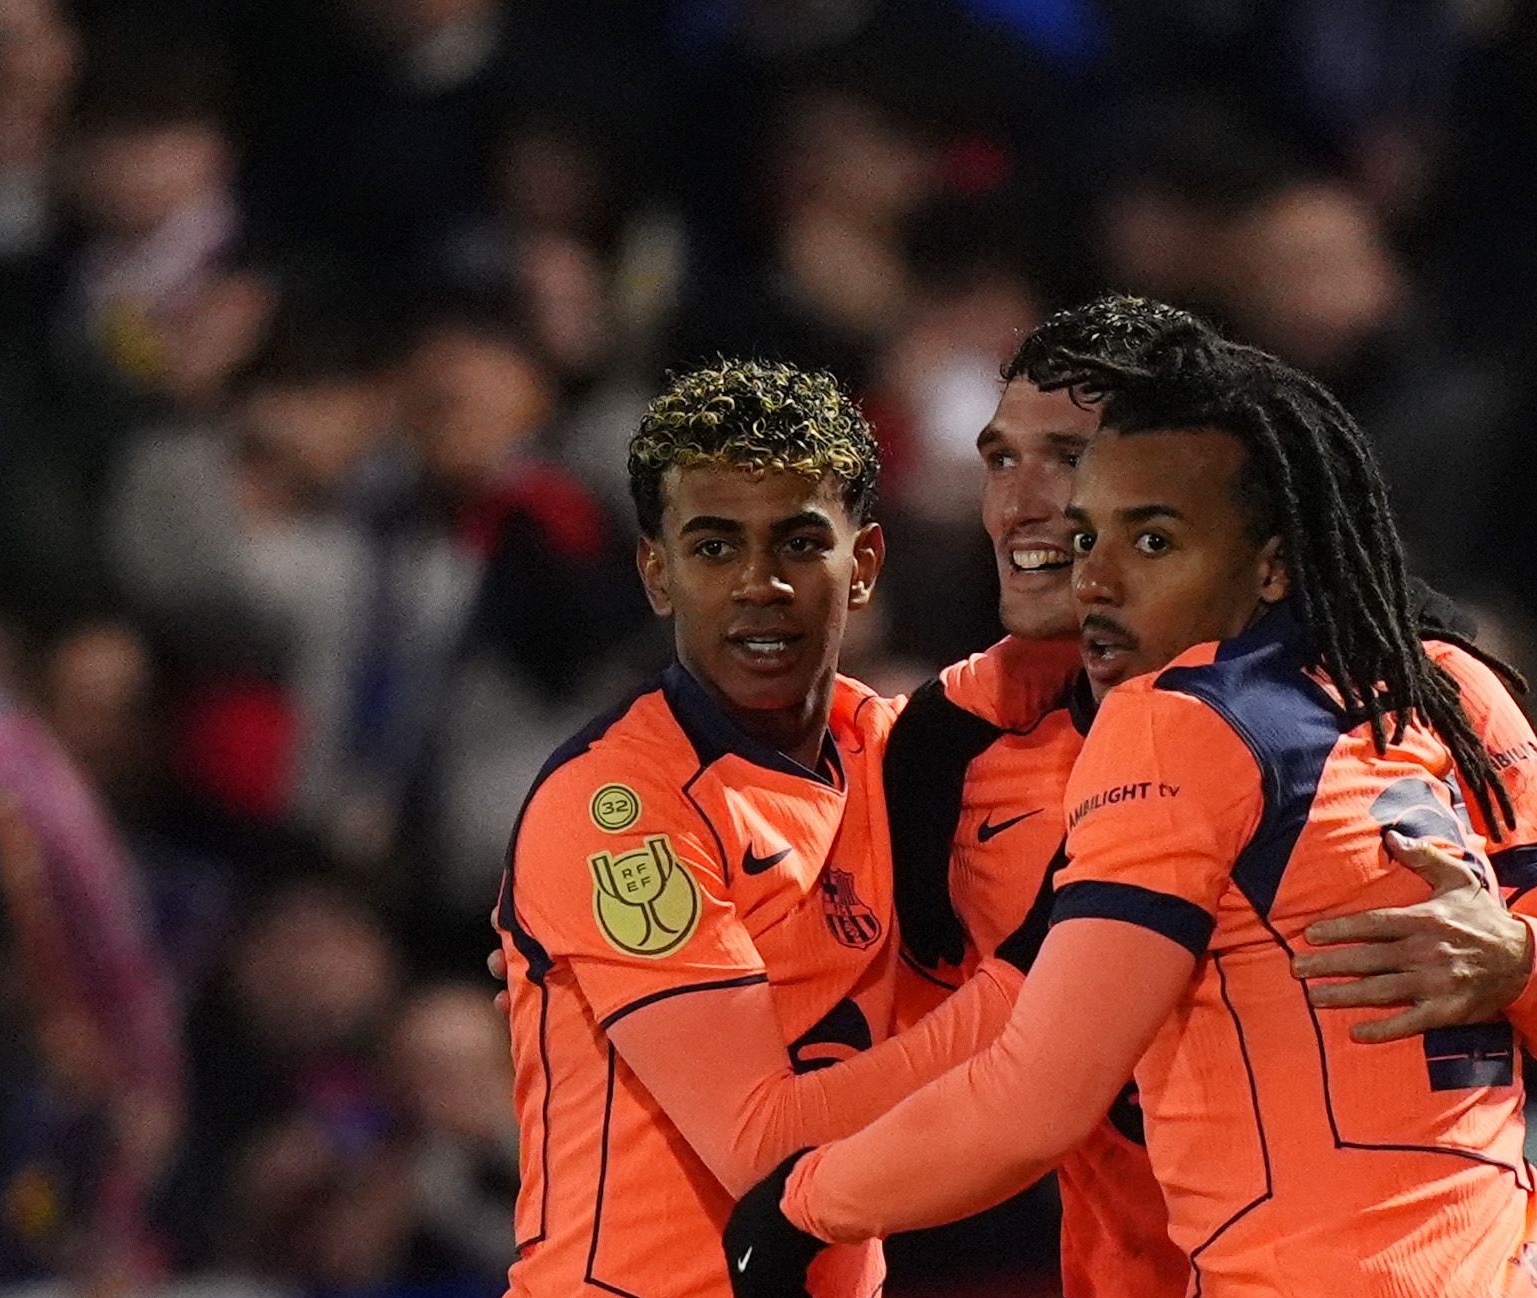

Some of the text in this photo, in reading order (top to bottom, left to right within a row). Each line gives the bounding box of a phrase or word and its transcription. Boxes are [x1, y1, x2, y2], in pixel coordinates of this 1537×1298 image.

[602, 800, 629, 815] 32
[1069, 782, 1180, 831] AMBILIGHT tv
